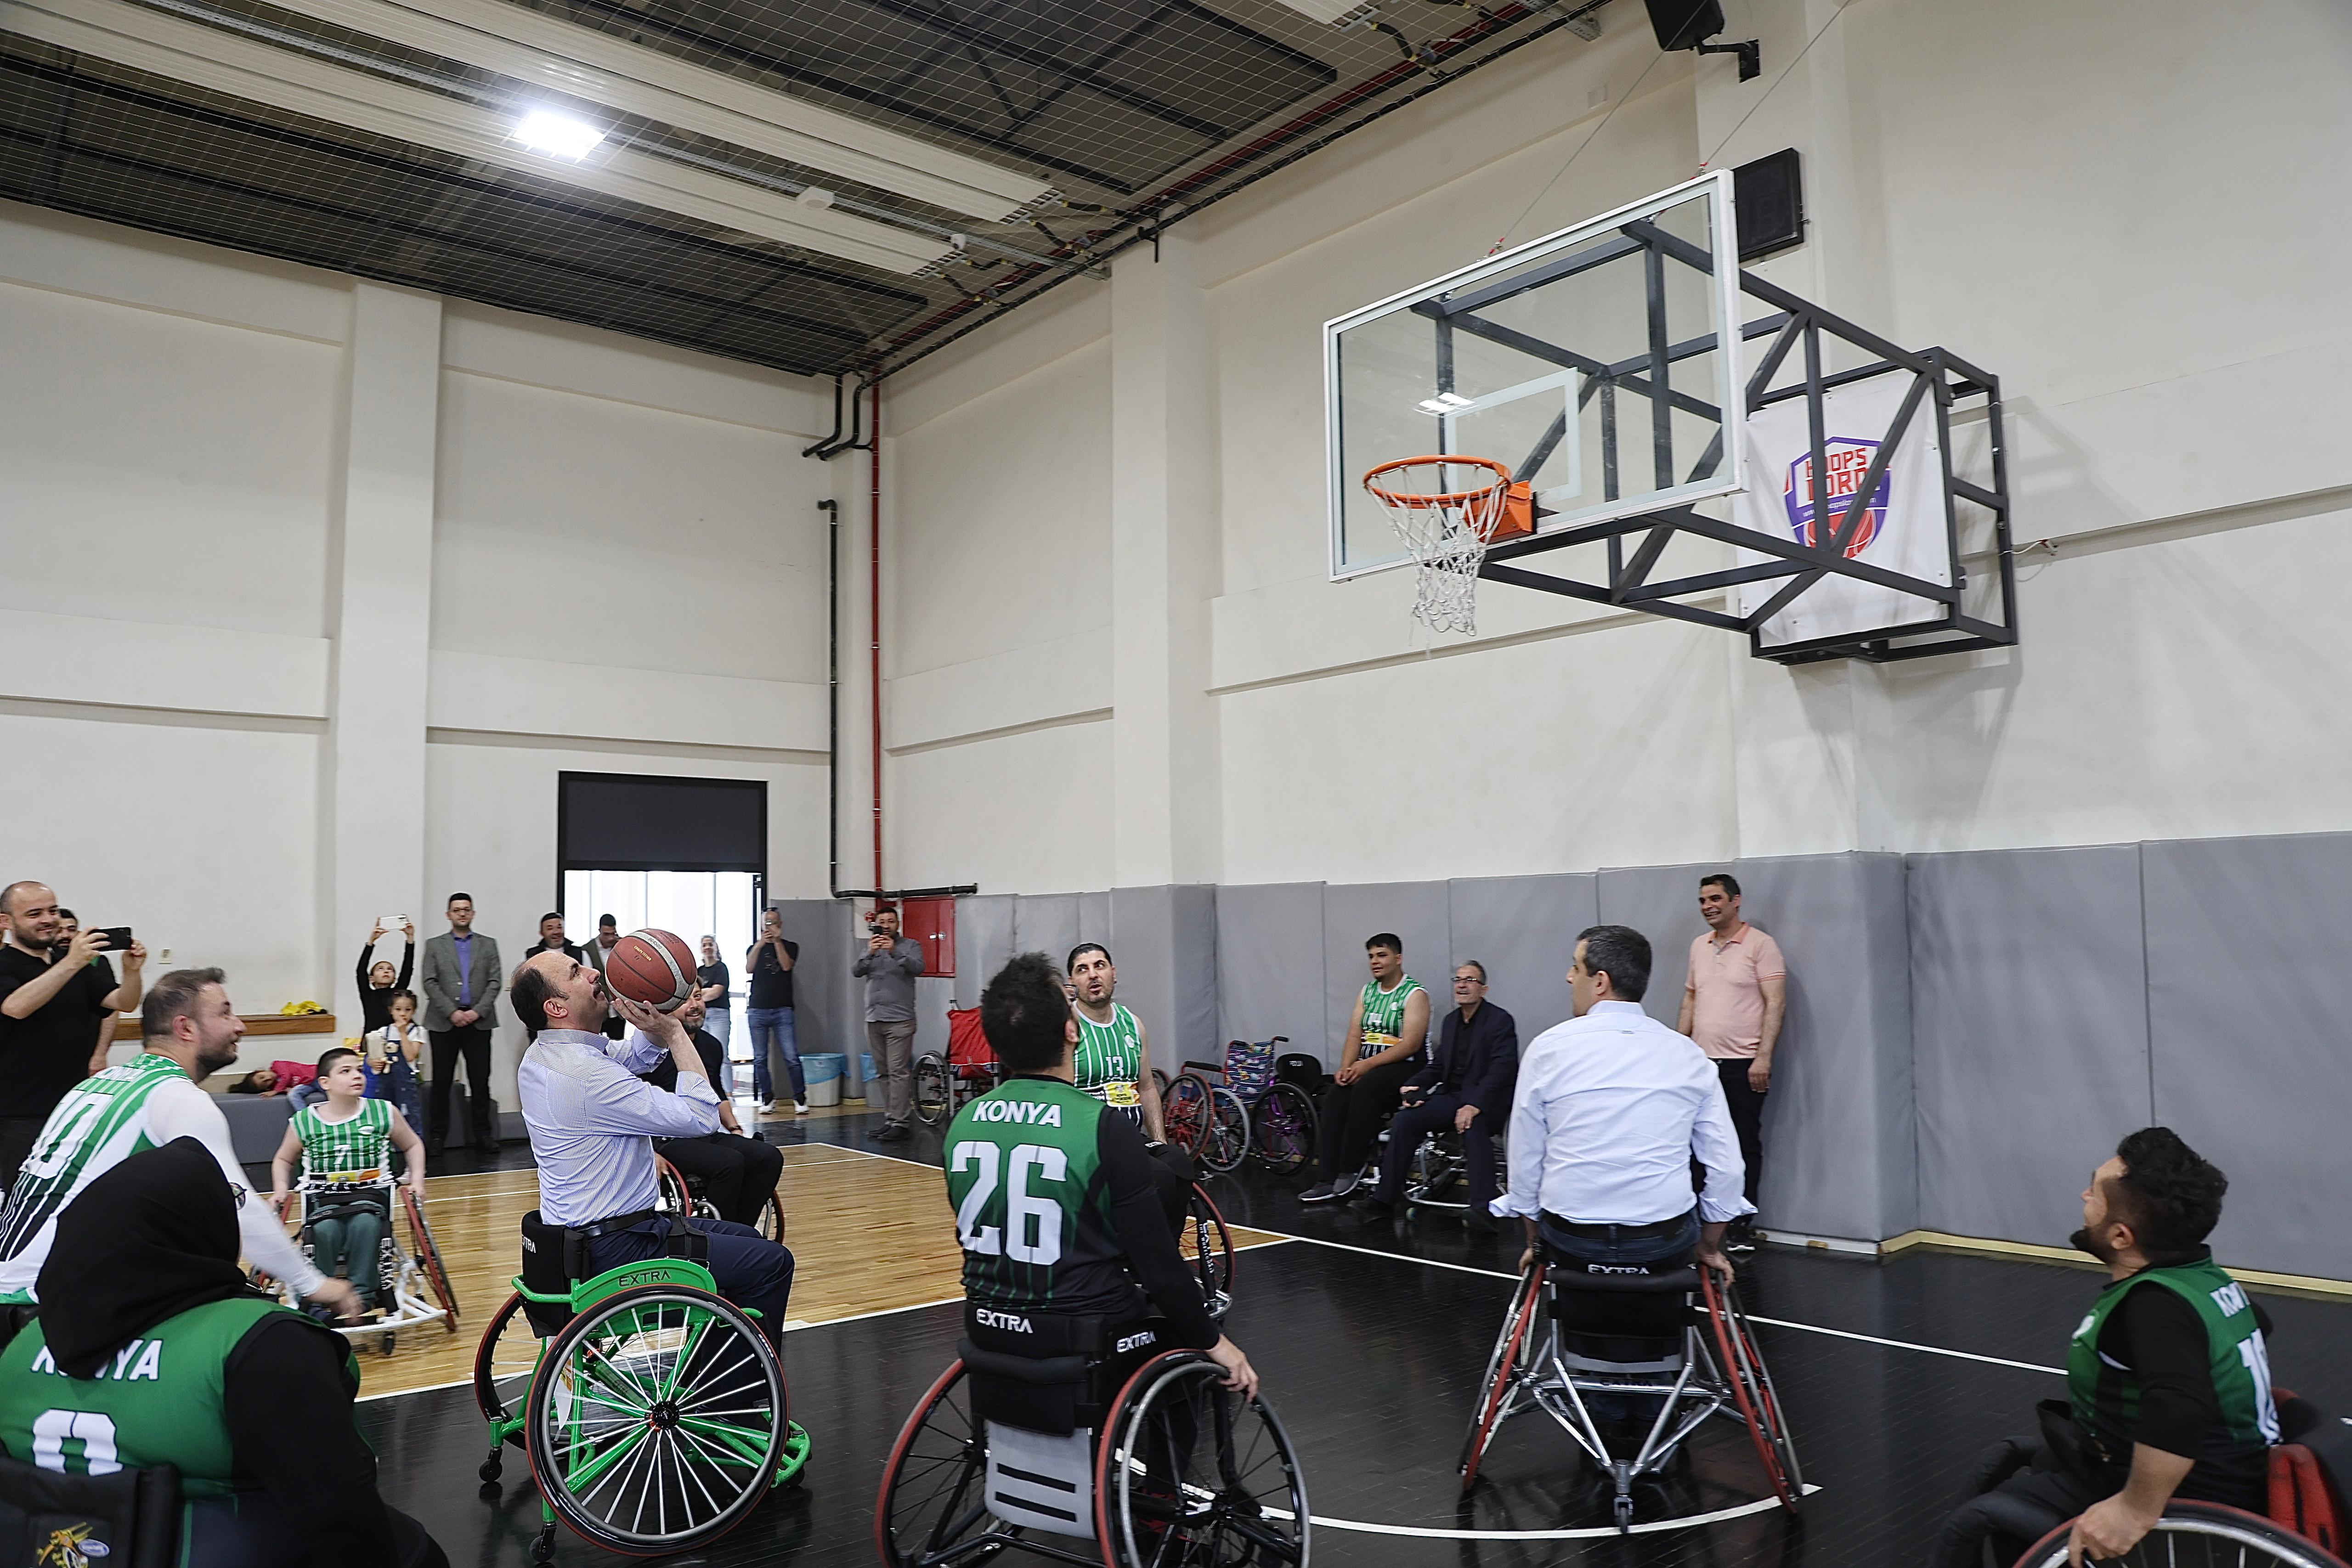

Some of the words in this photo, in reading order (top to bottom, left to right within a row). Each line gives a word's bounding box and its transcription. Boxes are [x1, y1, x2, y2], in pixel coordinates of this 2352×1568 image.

[1805, 447, 1866, 478] HOPS
[633, 946, 652, 961] COMPETITION
[1105, 1056, 1125, 1078] 13
[972, 1100, 1062, 1128] KONYA
[950, 1141, 1068, 1265] 26
[619, 1269, 671, 1286] EXTRA
[976, 1308, 1034, 1334] EXTRA
[1116, 1331, 1157, 1354] EXTRA
[30, 1339, 162, 1380] KYA
